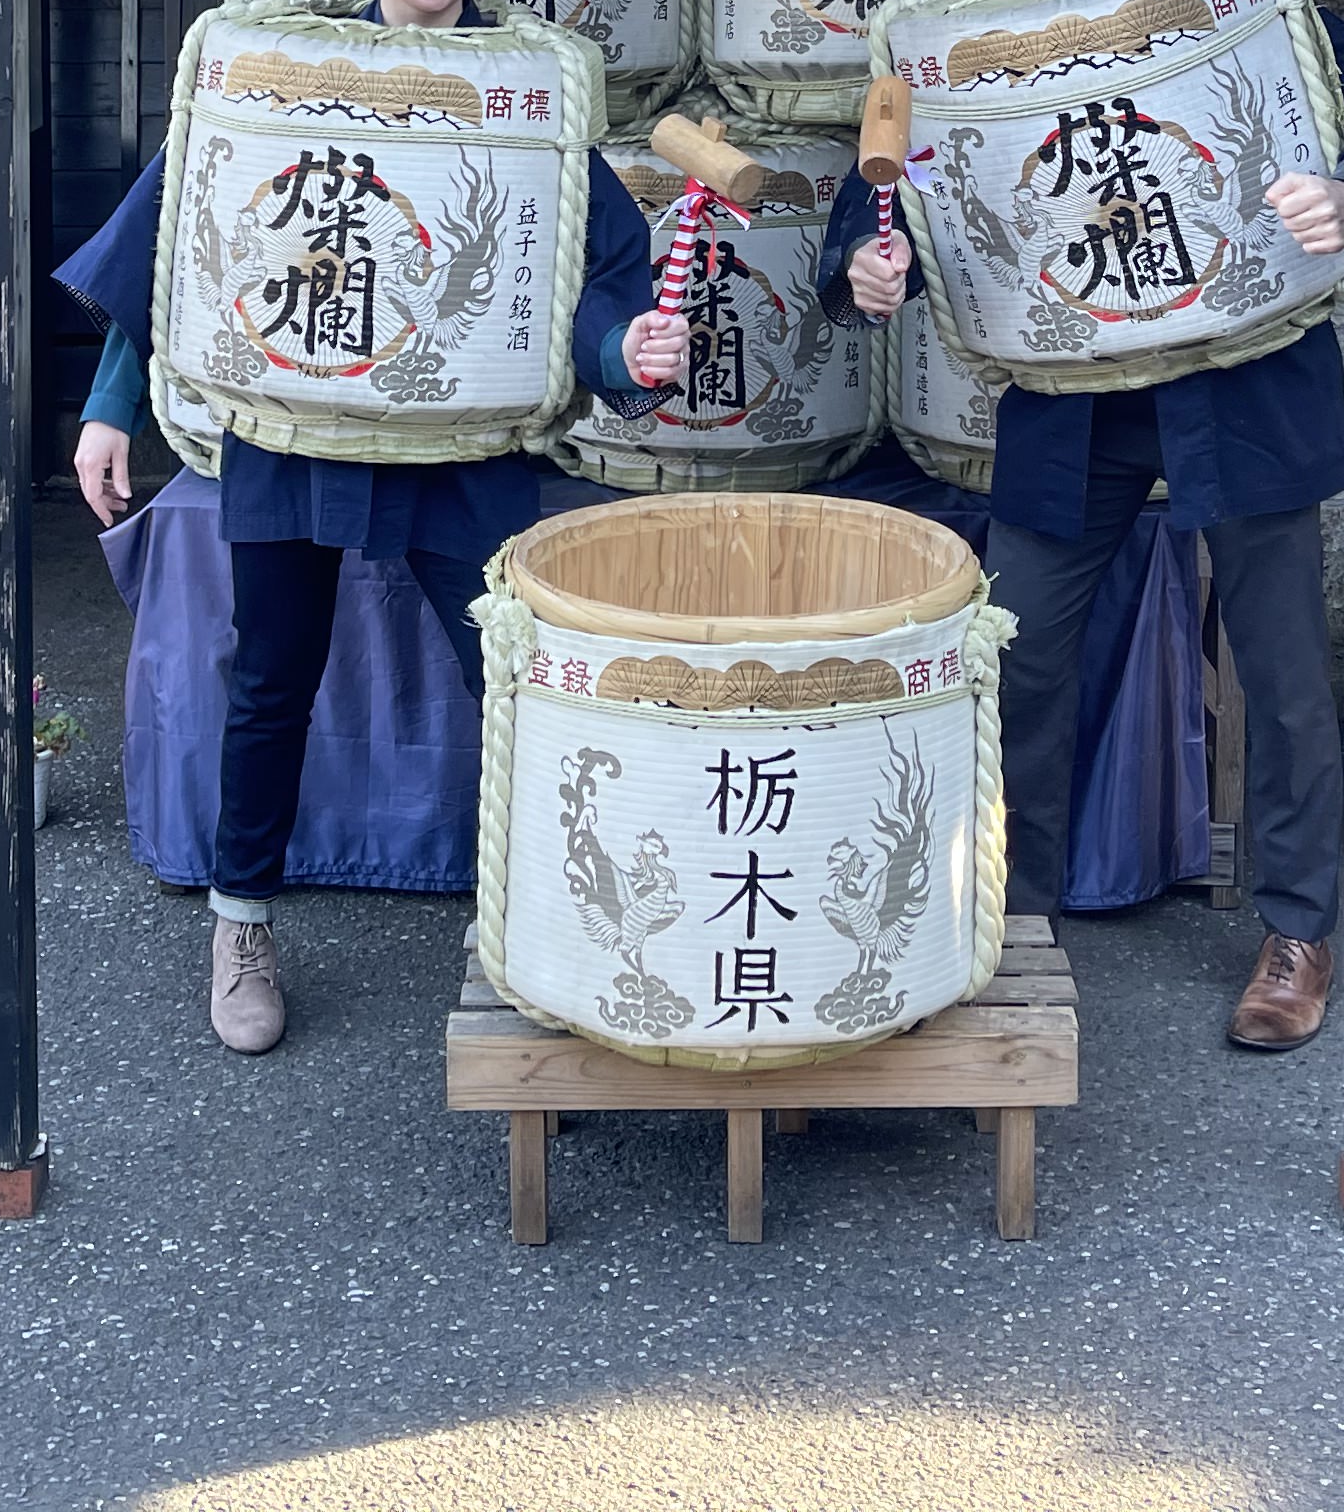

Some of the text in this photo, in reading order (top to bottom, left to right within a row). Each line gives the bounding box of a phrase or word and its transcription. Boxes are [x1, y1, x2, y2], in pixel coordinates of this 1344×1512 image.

[485, 85, 552, 122] 商標
[897, 56, 947, 90] 登録
[1275, 76, 1318, 176] 益子の
[1038, 97, 1197, 302] 燦爛
[260, 145, 392, 360] 燦爛
[507, 197, 539, 352] 益子の銘酒
[528, 648, 593, 696] 登録
[904, 647, 962, 696] 商標
[704, 748, 799, 1031] 栃木県
